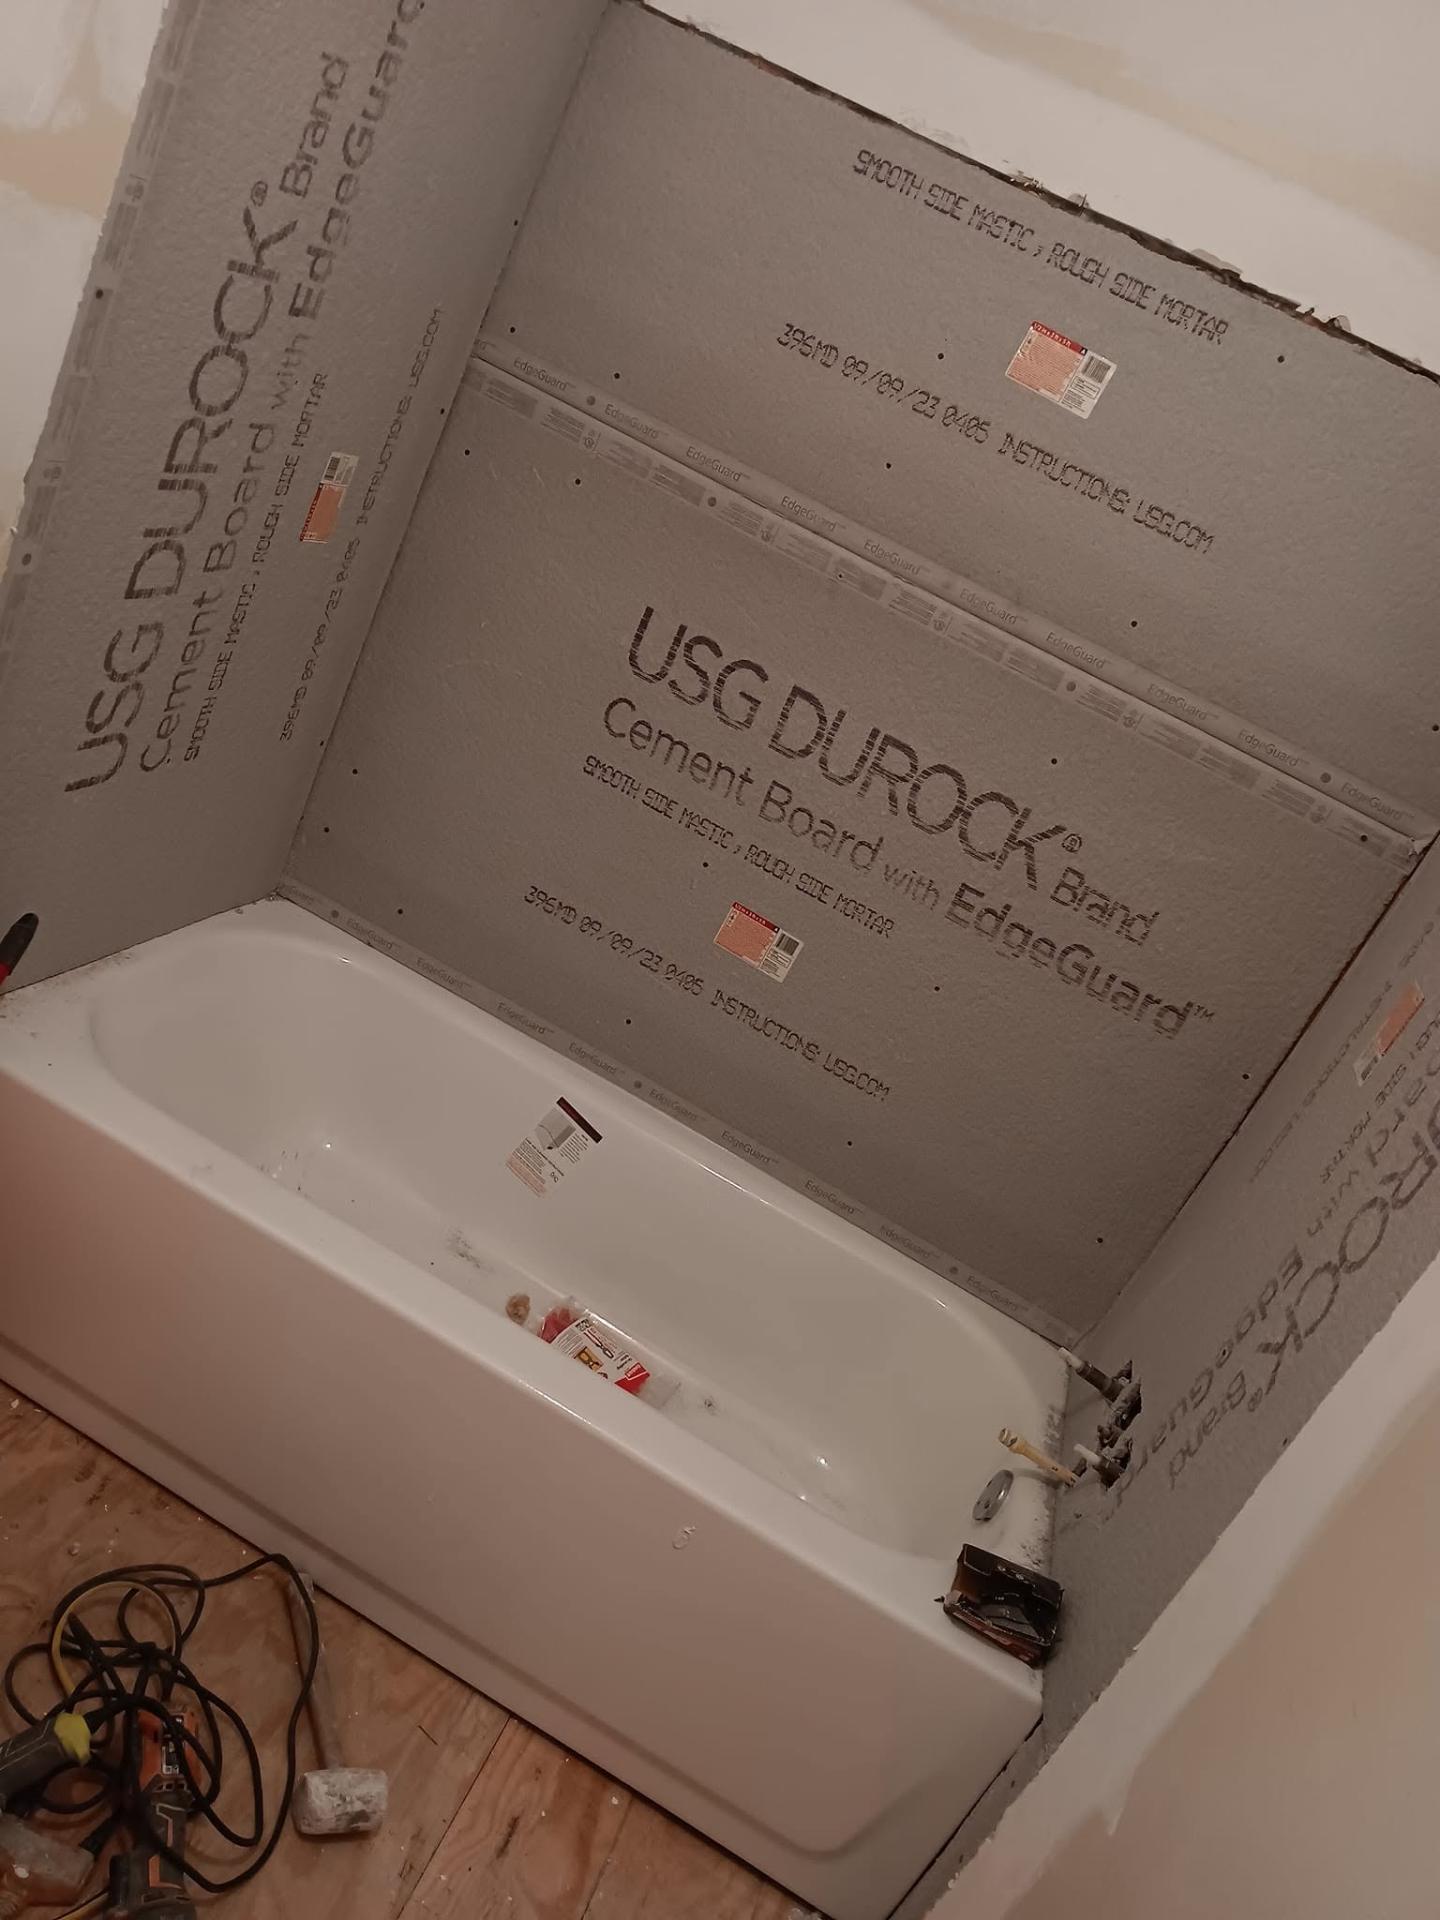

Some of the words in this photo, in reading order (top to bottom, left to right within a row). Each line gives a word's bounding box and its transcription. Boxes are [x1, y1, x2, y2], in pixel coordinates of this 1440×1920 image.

[852, 149, 923, 200] SMOOTH
[924, 184, 969, 220] SIDE
[968, 204, 1034, 251] MASTIC
[1047, 243, 1109, 289] ROUGH
[1109, 273, 1156, 310] SIDE
[1154, 295, 1229, 345] MORTAR
[65, 622, 163, 792] USG
[280, 52, 349, 198] Brand
[140, 589, 222, 772] Cement
[204, 422, 274, 573] Board
[271, 333, 310, 410] with
[208, 650, 232, 691] SIDE
[224, 583, 256, 644] MASTIC
[275, 455, 299, 496] SIDE
[291, 372, 328, 447] MORTAR
[584, 755, 641, 799] SMOOTH
[642, 787, 679, 820] SIDE
[678, 807, 734, 850] MASTIC
[744, 843, 795, 884] ROUGH
[795, 872, 833, 905] SIDE
[832, 892, 895, 939] MORTAR
[604, 698, 753, 806] Cement
[759, 780, 883, 871] Board
[884, 863, 939, 911] with
[629, 606, 768, 731] USG
[1050, 866, 1160, 946] Brand
[1169, 1369, 1246, 1490] Brand
